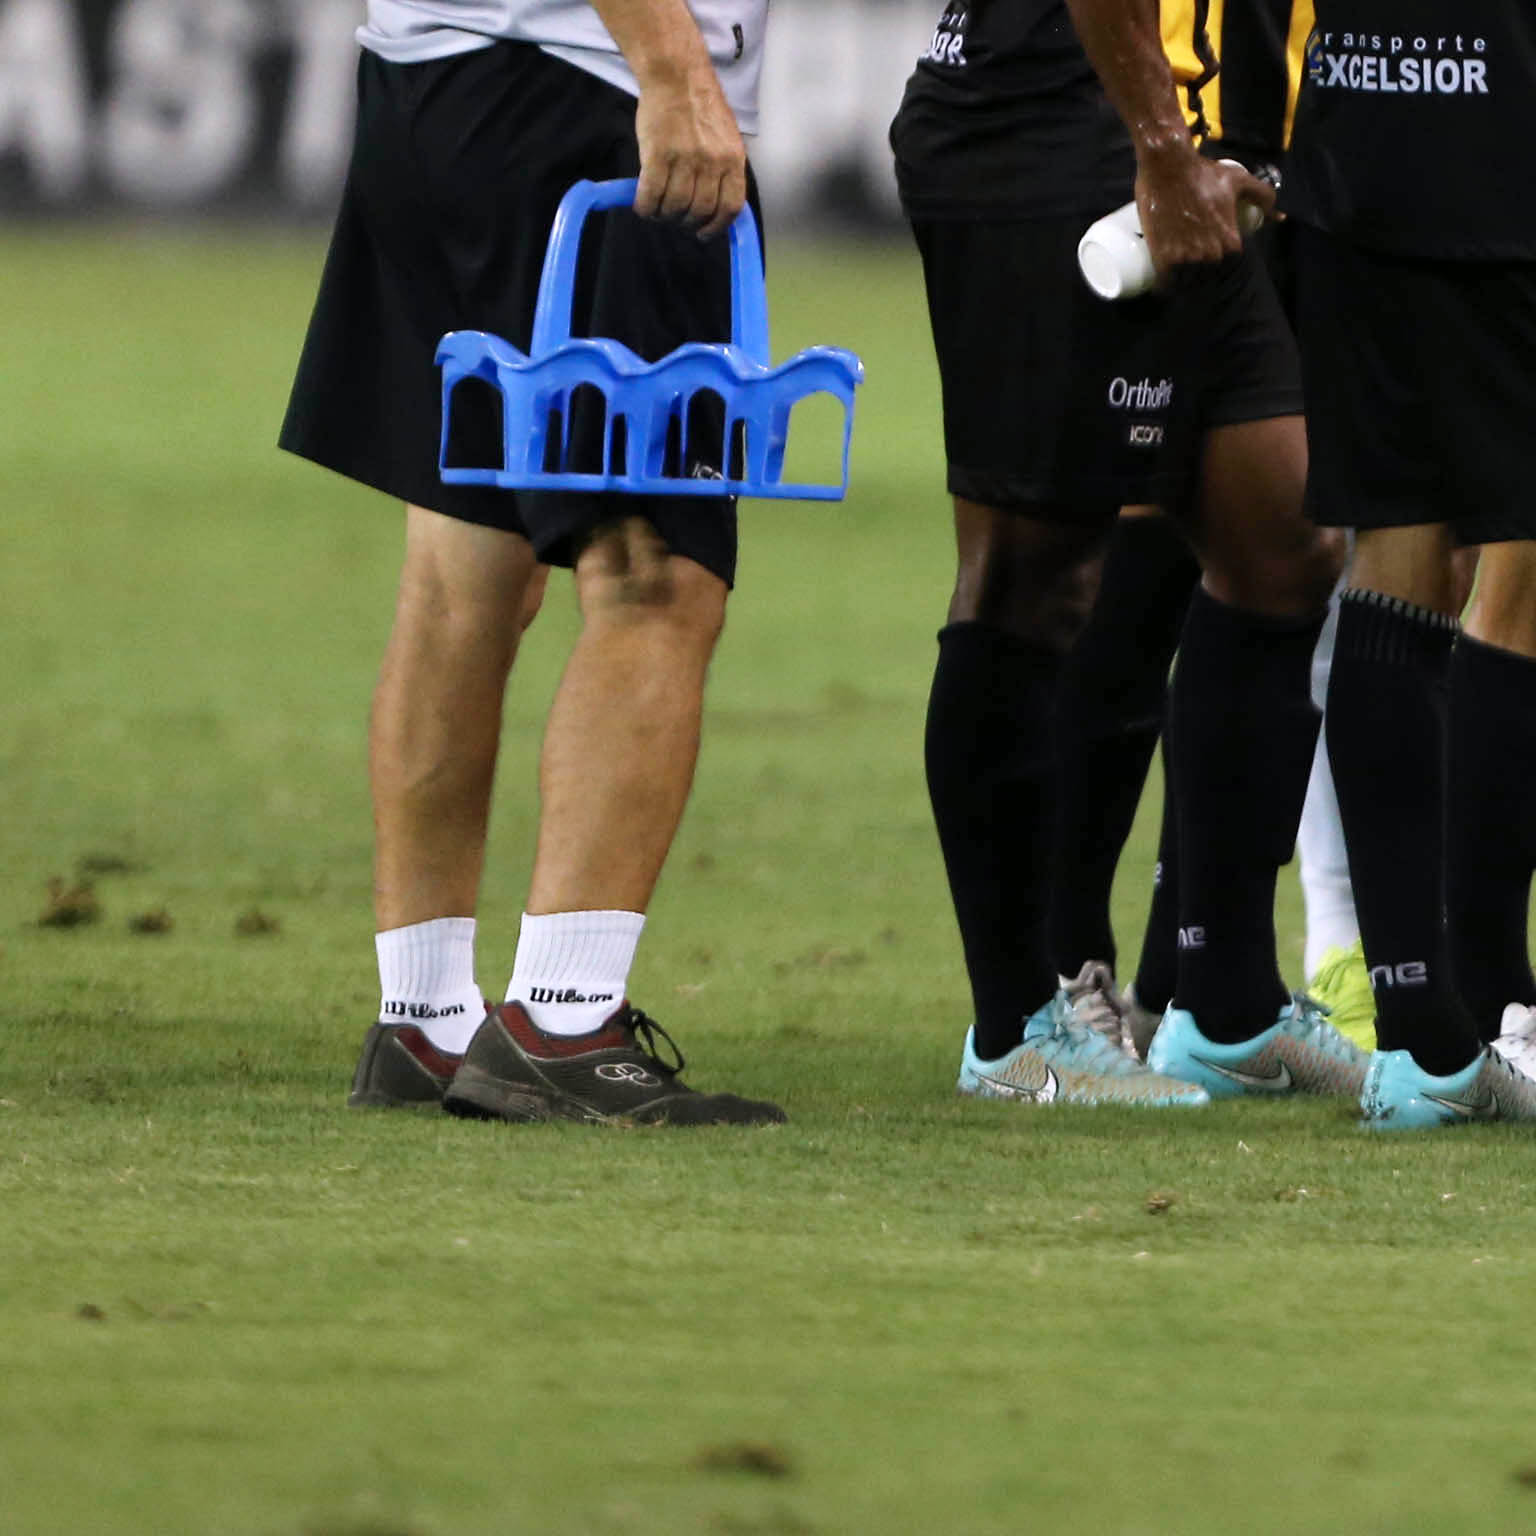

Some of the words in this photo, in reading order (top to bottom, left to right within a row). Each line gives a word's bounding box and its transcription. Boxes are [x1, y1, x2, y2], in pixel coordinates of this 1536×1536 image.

[1324, 32, 1487, 54] ransporte
[1318, 54, 1489, 94] XCELSIOR
[530, 987, 614, 1004] Wilson
[384, 1000, 467, 1019] Wilson
